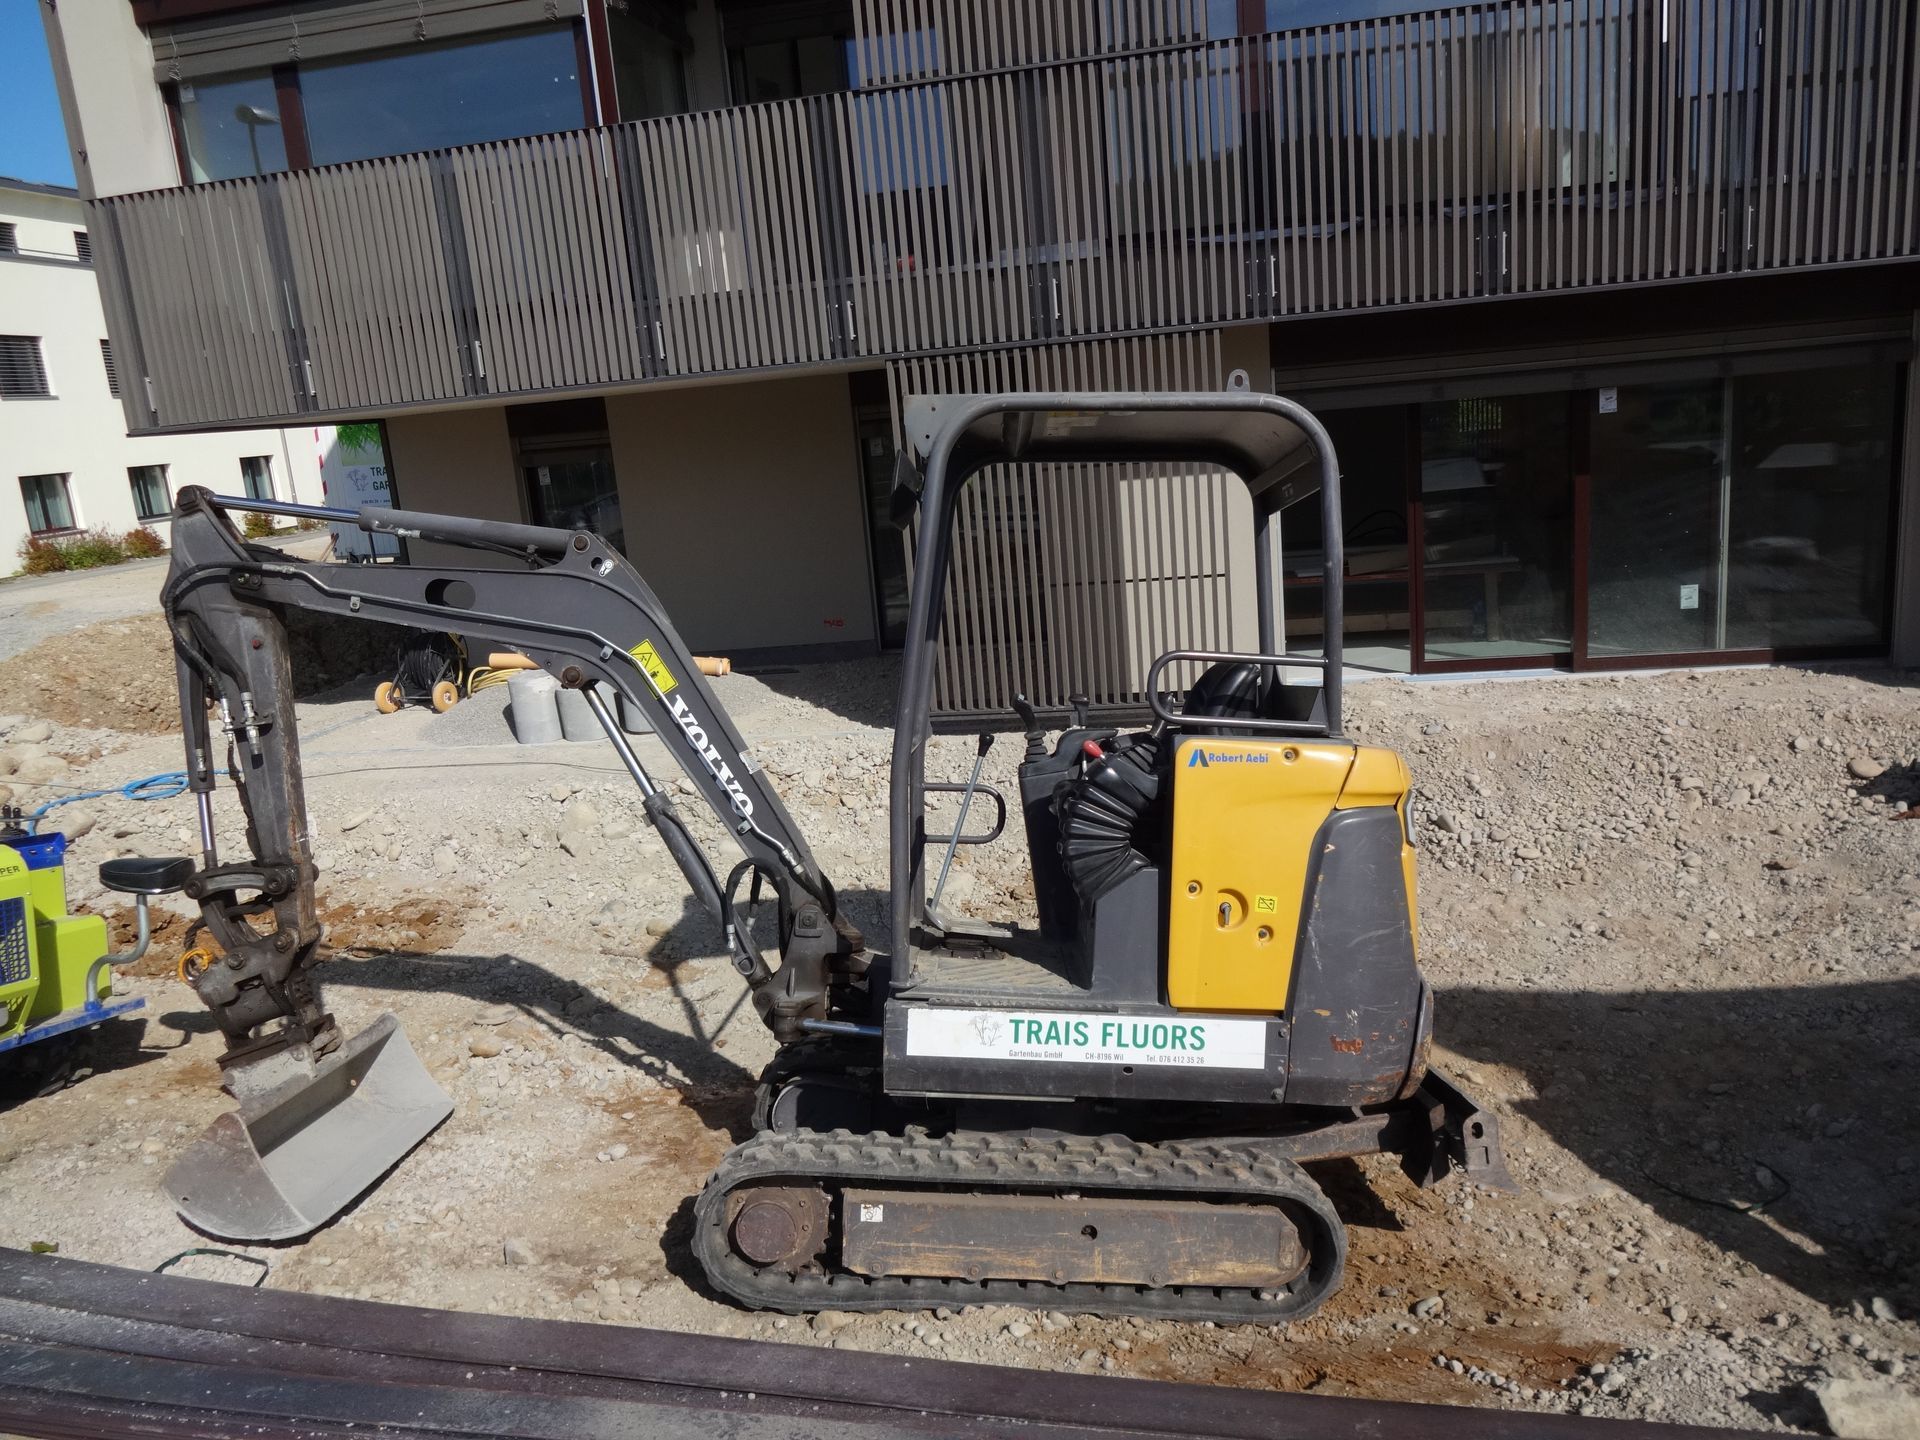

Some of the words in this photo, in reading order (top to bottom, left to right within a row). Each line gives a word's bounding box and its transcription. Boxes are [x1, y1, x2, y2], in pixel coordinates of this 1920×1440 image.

[672, 694, 754, 818] VOLVO
[1208, 752, 1243, 763] Robert
[1246, 753, 1269, 764] Aebi
[1009, 1018, 1089, 1047] TRAIS
[1101, 1022, 1206, 1051] FLUORS
[1008, 1050, 1042, 1058] Gartenbau
[1044, 1051, 1063, 1059] GmbH
[1085, 1052, 1112, 1062] CH-8196
[1113, 1053, 1124, 1062] Wil
[1146, 1054, 1158, 1063] Tel.
[1159, 1055, 1171, 1064] 076
[1172, 1055, 1185, 1065] 412
[1186, 1056, 1195, 1065] 35
